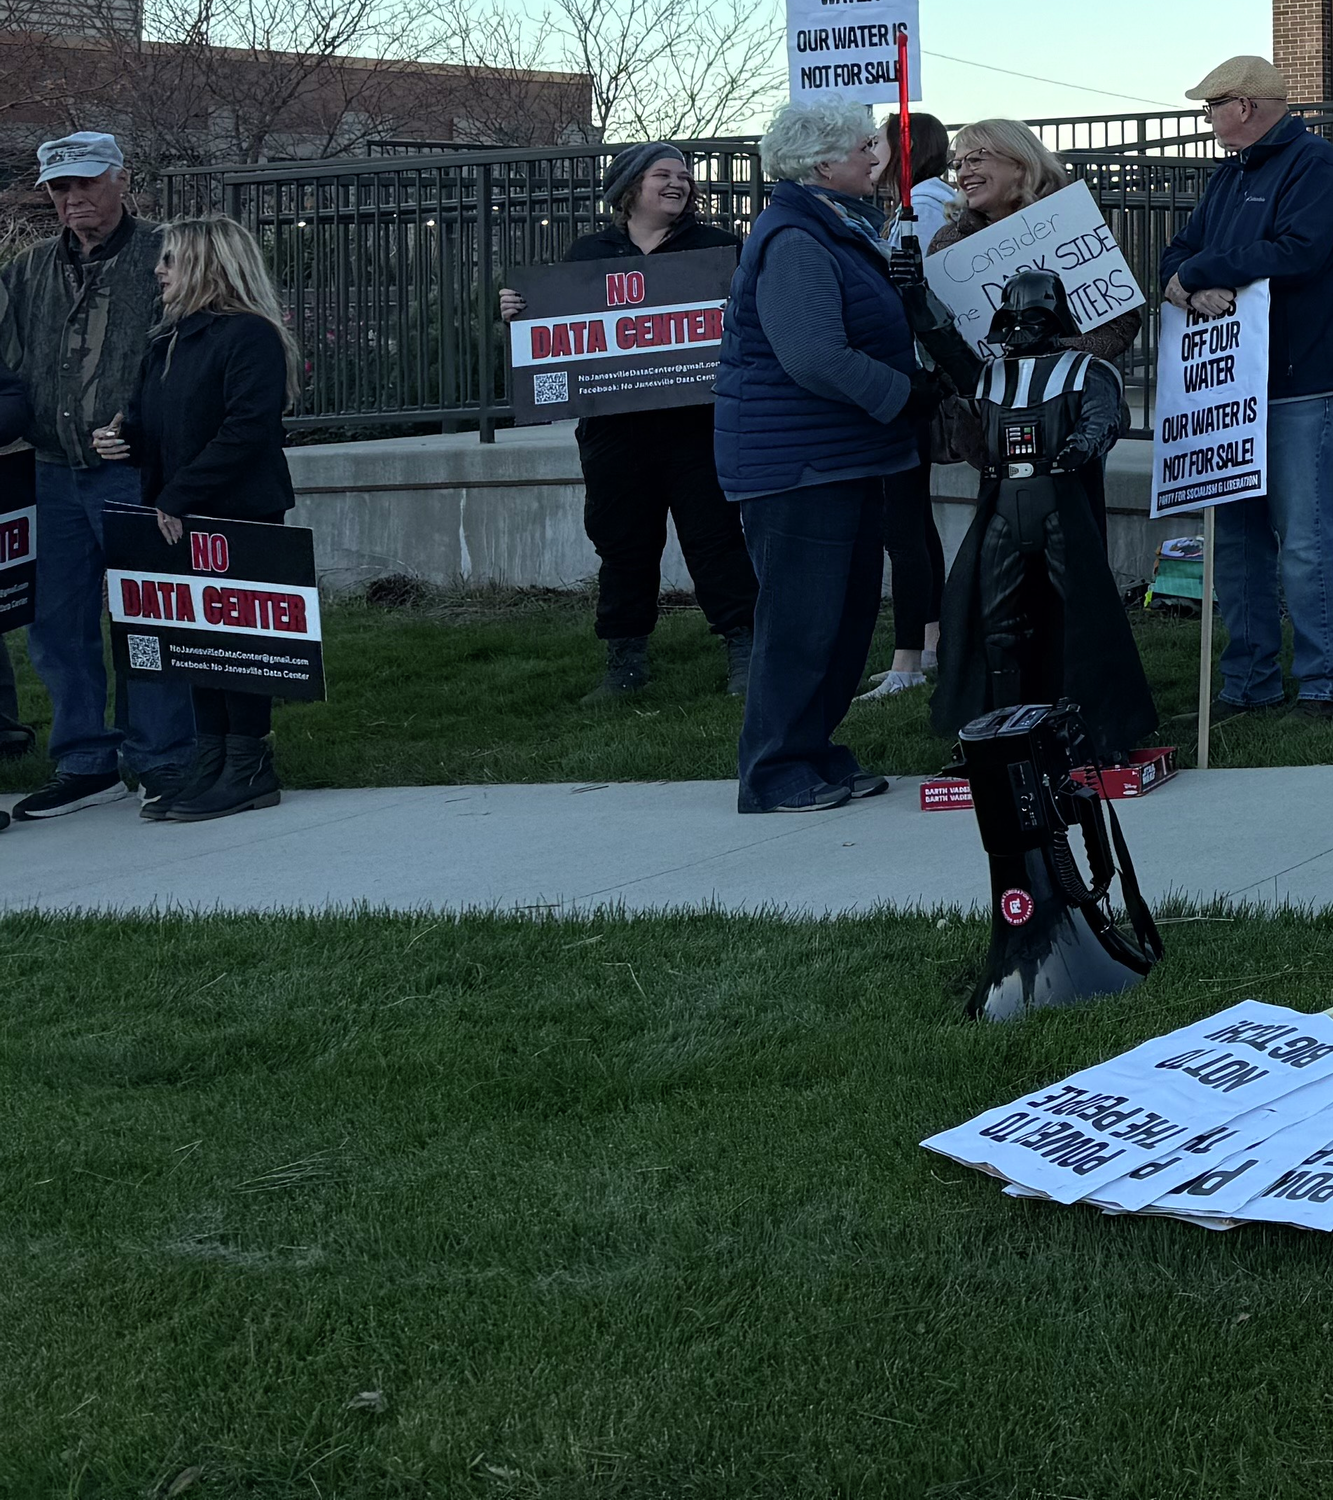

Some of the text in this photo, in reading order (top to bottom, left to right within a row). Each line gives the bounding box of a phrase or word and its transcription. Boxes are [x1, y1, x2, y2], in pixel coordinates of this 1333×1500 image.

[797, 22, 908, 52] OUR WATER IS
[801, 65, 831, 89] NOT
[834, 63, 863, 87] FOR
[943, 214, 1059, 283] Consider
[1055, 223, 1119, 270] SIDE
[606, 270, 645, 307] NO
[530, 307, 724, 360] DATA CENTER
[1181, 321, 1240, 362] OFF OUR
[621, 382, 633, 390] No
[634, 377, 674, 389] Janesville
[676, 375, 695, 384] Data
[1184, 354, 1235, 394] WATER
[1162, 396, 1257, 444] OUR WATER IS
[1163, 437, 1254, 483] NOT FOR SALE!
[190, 531, 229, 573] NO
[121, 578, 308, 634] DATA CENTER
[169, 644, 309, 667] NoJanesvilleDataCenter@gmail.com
[211, 662, 223, 672] No
[224, 664, 262, 677] Janesville
[263, 668, 282, 678] Data
[283, 670, 310, 681] Center
[925, 786, 948, 795] DARTH
[925, 795, 948, 803] DARTH
[1154, 1049, 1270, 1093] NOT TO
[1026, 1085, 1144, 1131] PEOPLE
[978, 1112, 1127, 1176] POWER TO
[1109, 1112, 1188, 1149] THE
